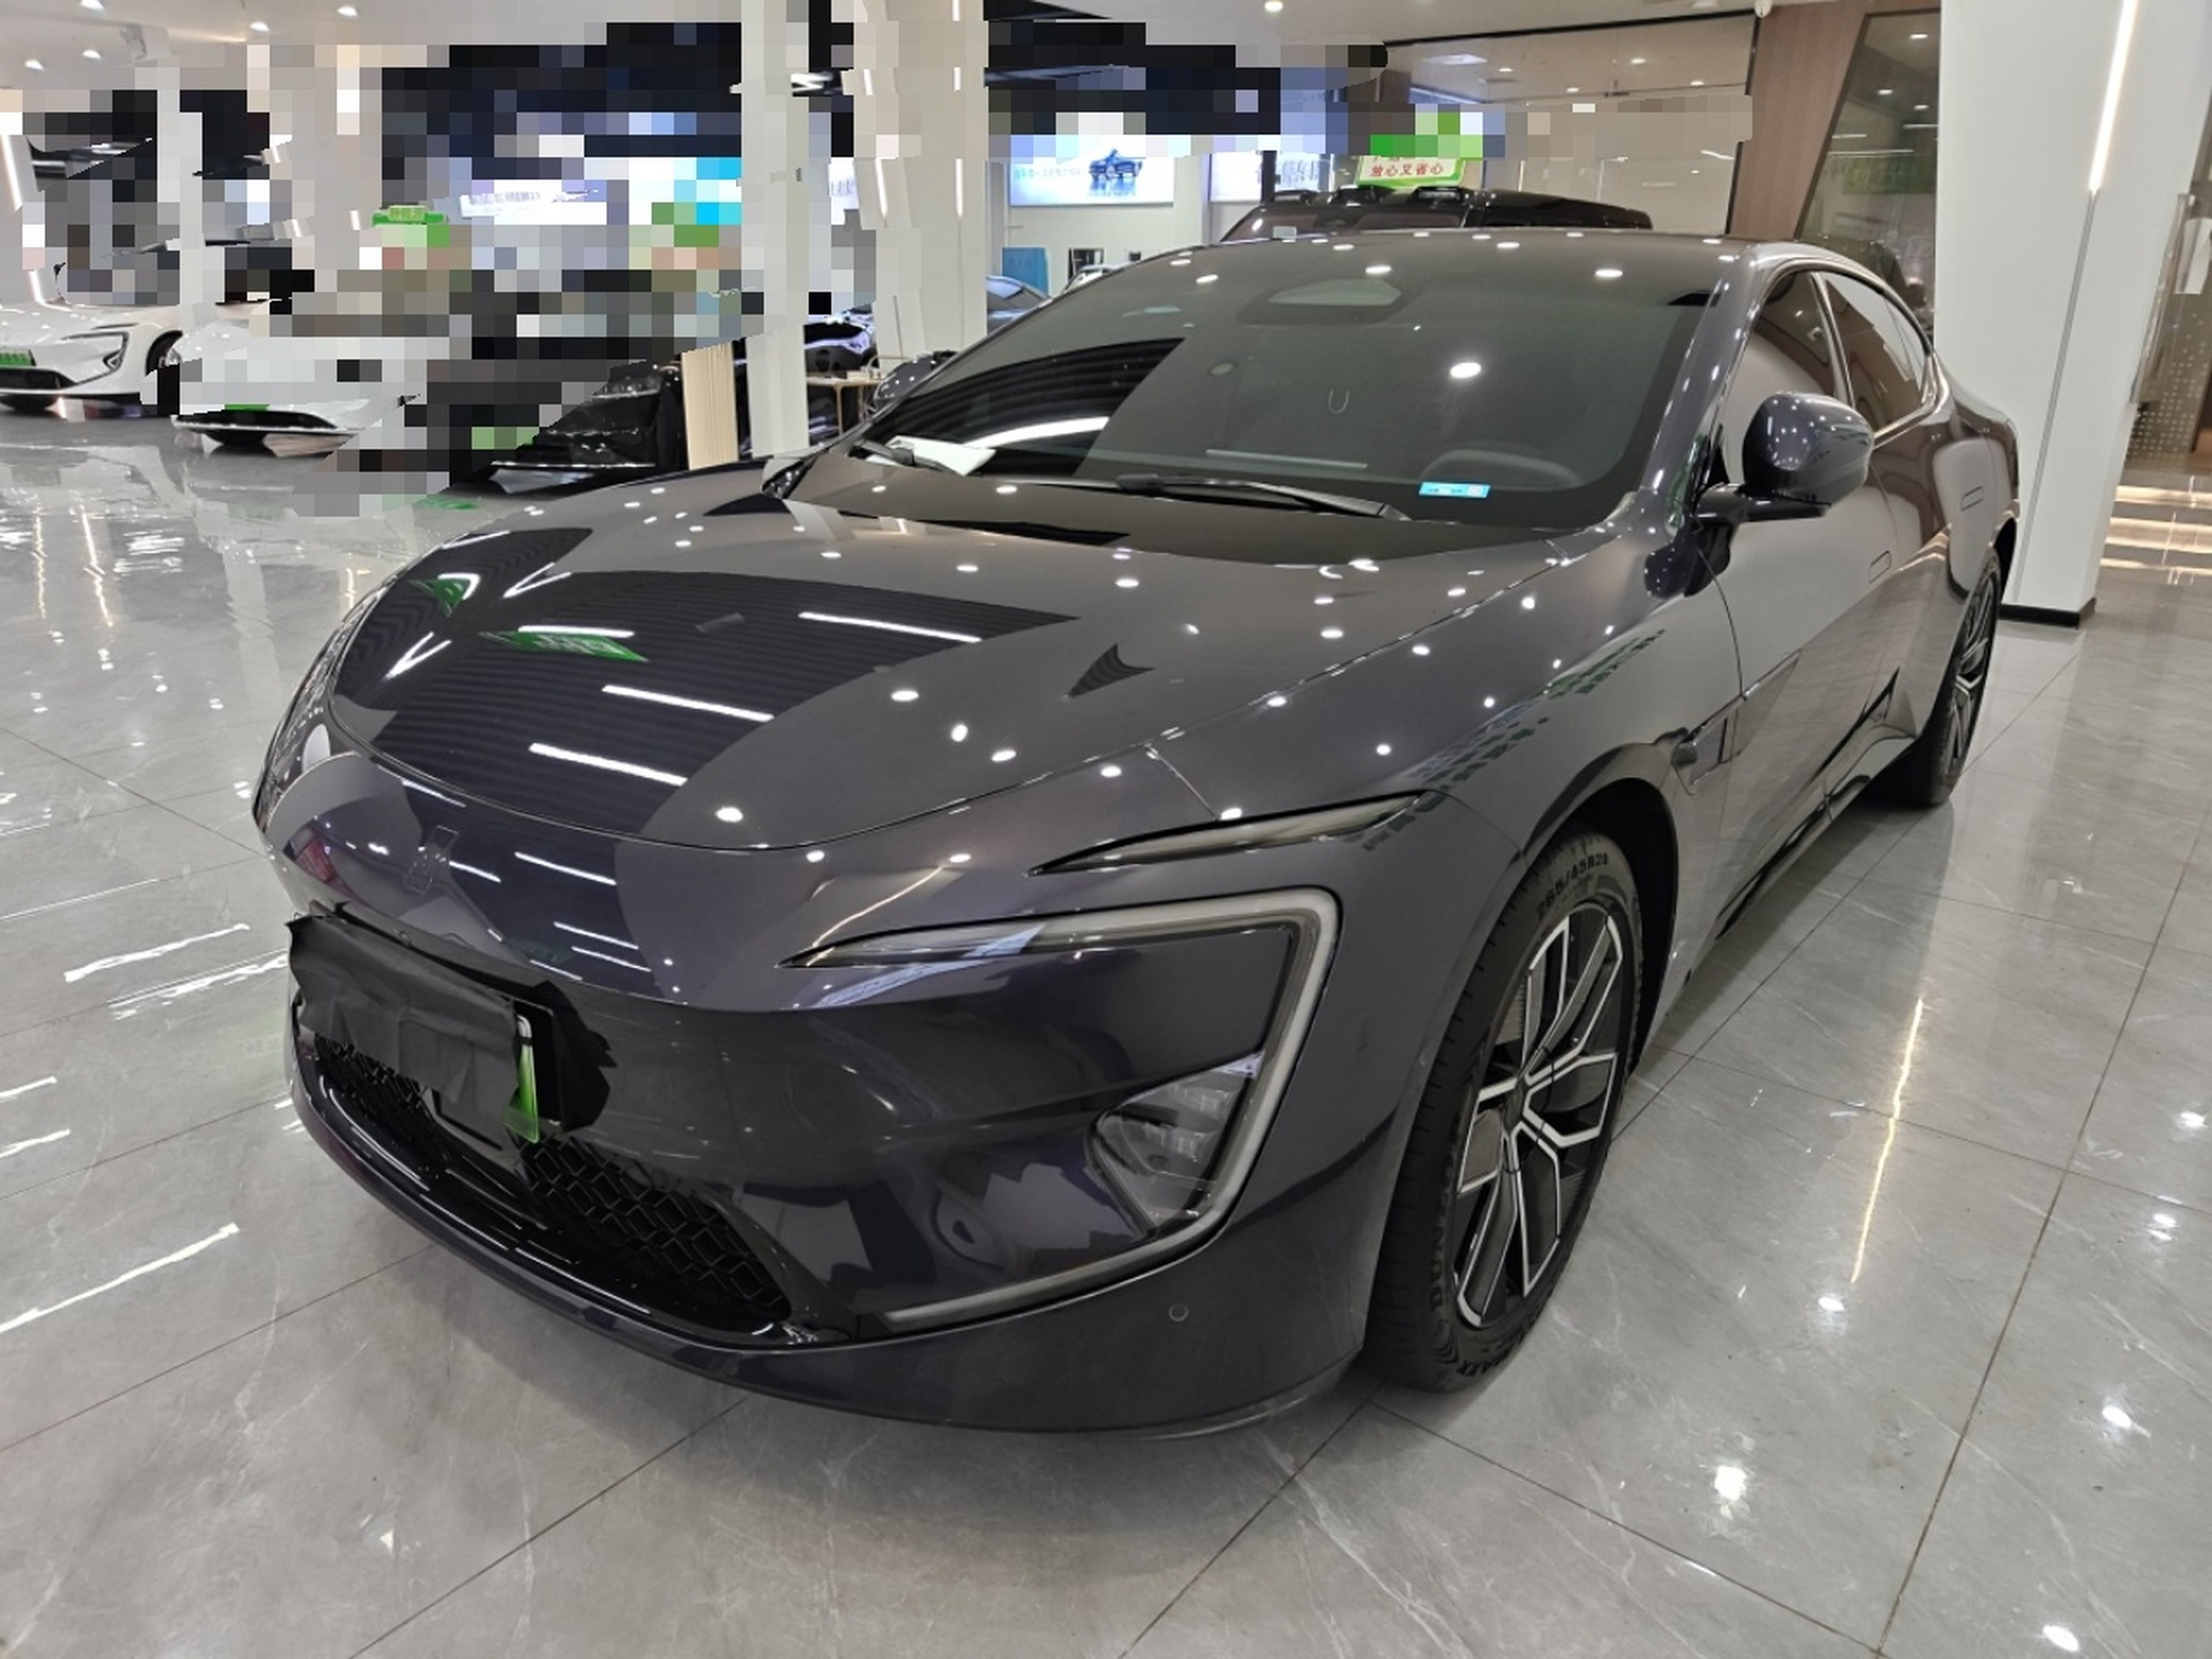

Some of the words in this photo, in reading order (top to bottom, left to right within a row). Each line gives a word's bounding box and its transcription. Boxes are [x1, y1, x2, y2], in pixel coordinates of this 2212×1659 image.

[1370, 163, 1444, 177] 放心又省心
